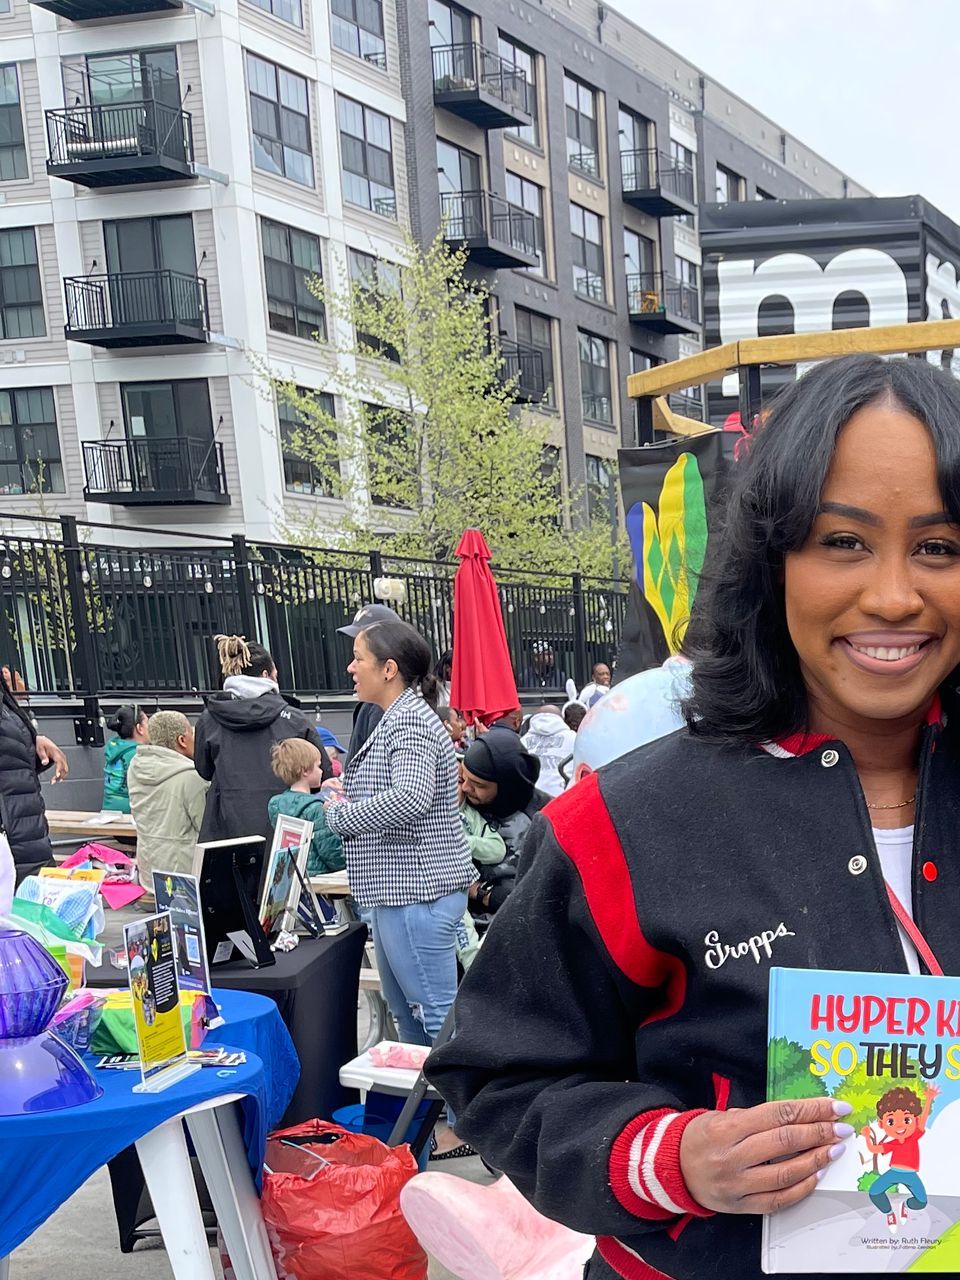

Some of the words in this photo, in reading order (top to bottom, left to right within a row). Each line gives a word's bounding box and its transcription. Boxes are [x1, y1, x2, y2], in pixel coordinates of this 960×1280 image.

[810, 994, 931, 1035] HYPER
[809, 1039, 859, 1077] SO
[859, 1041, 943, 1080] THEY
[861, 1237, 888, 1245] Written
[901, 1237, 919, 1245] Ruth
[920, 1237, 942, 1246] Fleury
